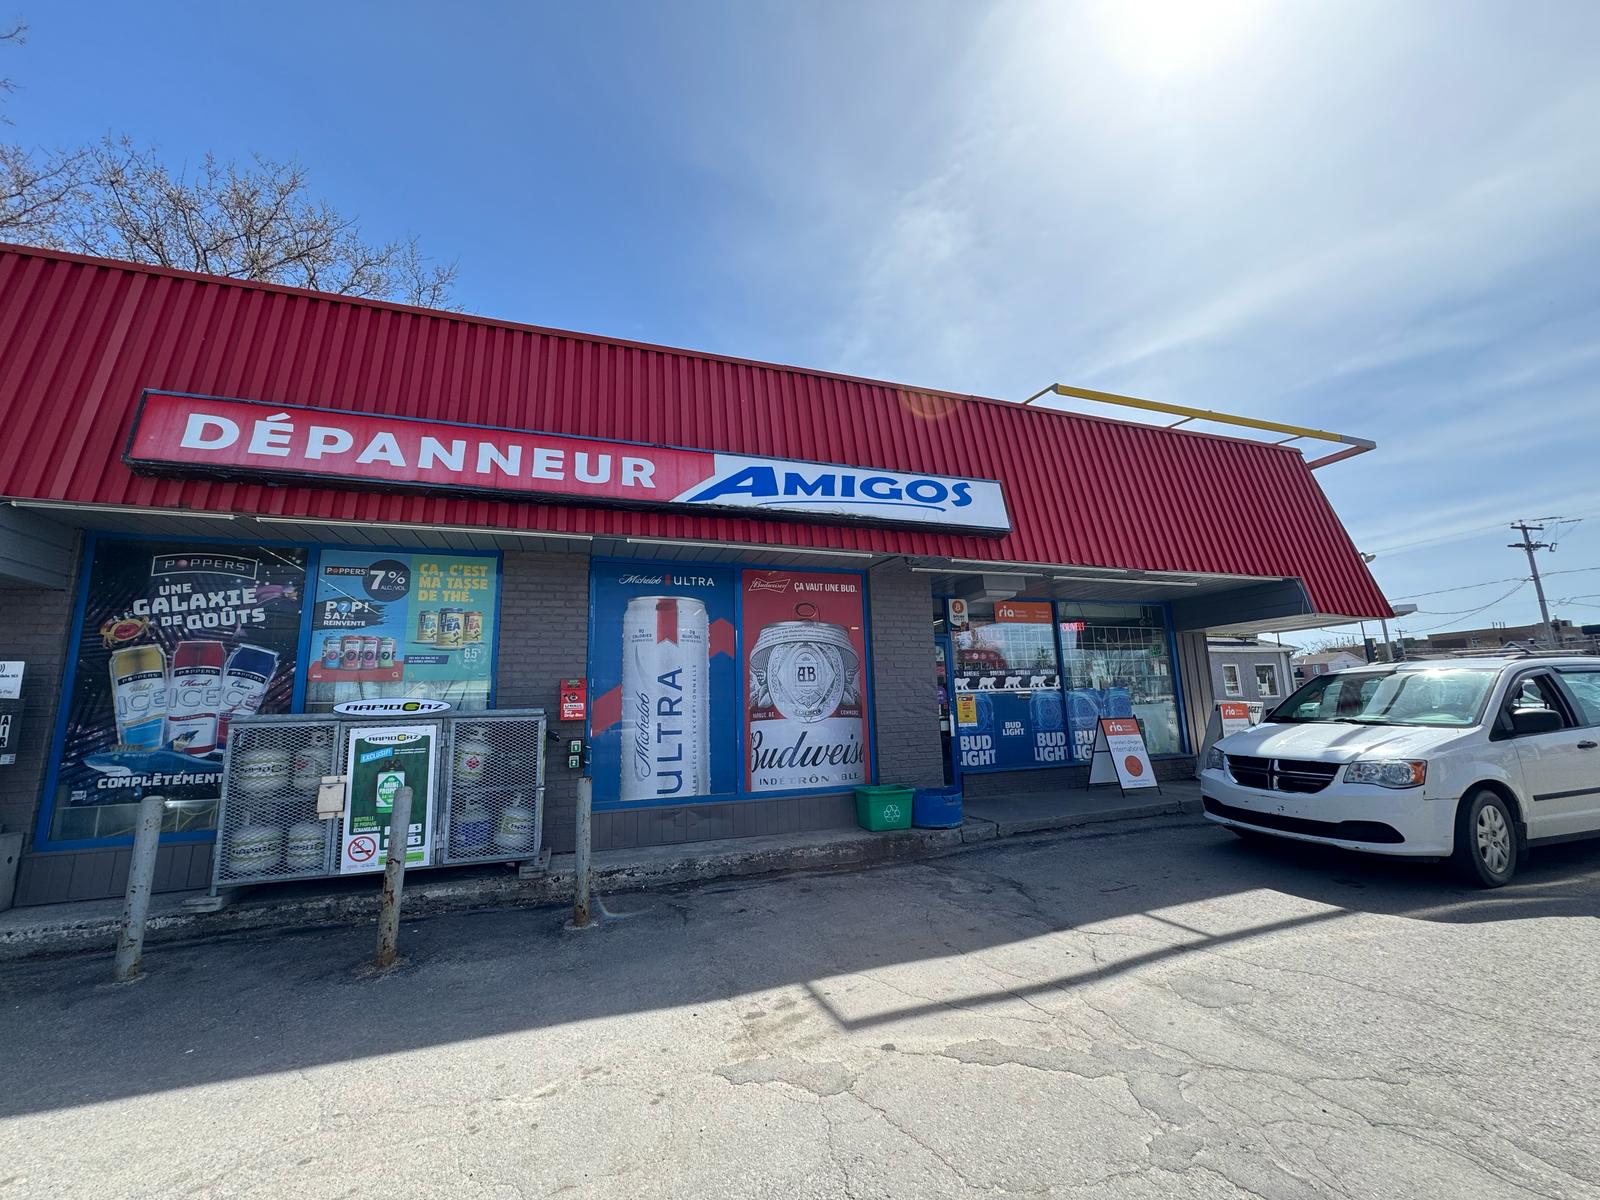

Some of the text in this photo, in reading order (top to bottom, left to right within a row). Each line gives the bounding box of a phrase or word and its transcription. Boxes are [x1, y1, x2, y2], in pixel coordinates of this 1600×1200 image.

[180, 412, 973, 507] DÉPANNEUR AMIGOS
[326, 567, 366, 575] POPPERS
[449, 564, 488, 577] C'EST
[370, 569, 406, 590] 7%
[418, 576, 488, 590] MA TASSE
[673, 576, 715, 587] ULTRA
[159, 583, 193, 596] UNE
[794, 582, 858, 593] ÇA VAUT UNE BUD.
[132, 587, 258, 616] GALAXIE
[417, 589, 437, 601] DE
[160, 606, 266, 630] DE GOÛTS
[998, 605, 1015, 618] ria
[440, 622, 461, 632] TEA
[118, 687, 166, 715] ICE
[168, 687, 221, 708] ICE
[221, 688, 263, 711] CE
[345, 702, 444, 712] RAPIDGAZ
[656, 668, 683, 795] ULTRA
[1002, 728, 1025, 736] LIGHT
[1004, 721, 1022, 729] BUD
[1109, 721, 1124, 732] ria
[368, 734, 419, 742] RAPIDGAZ
[634, 690, 651, 782] Michelob
[959, 735, 992, 751] BUD
[1036, 731, 1066, 747] BUD
[960, 749, 997, 766] IGHT
[1072, 744, 1094, 759] LIG
[759, 772, 859, 786] INDÉTRÔNBLE
